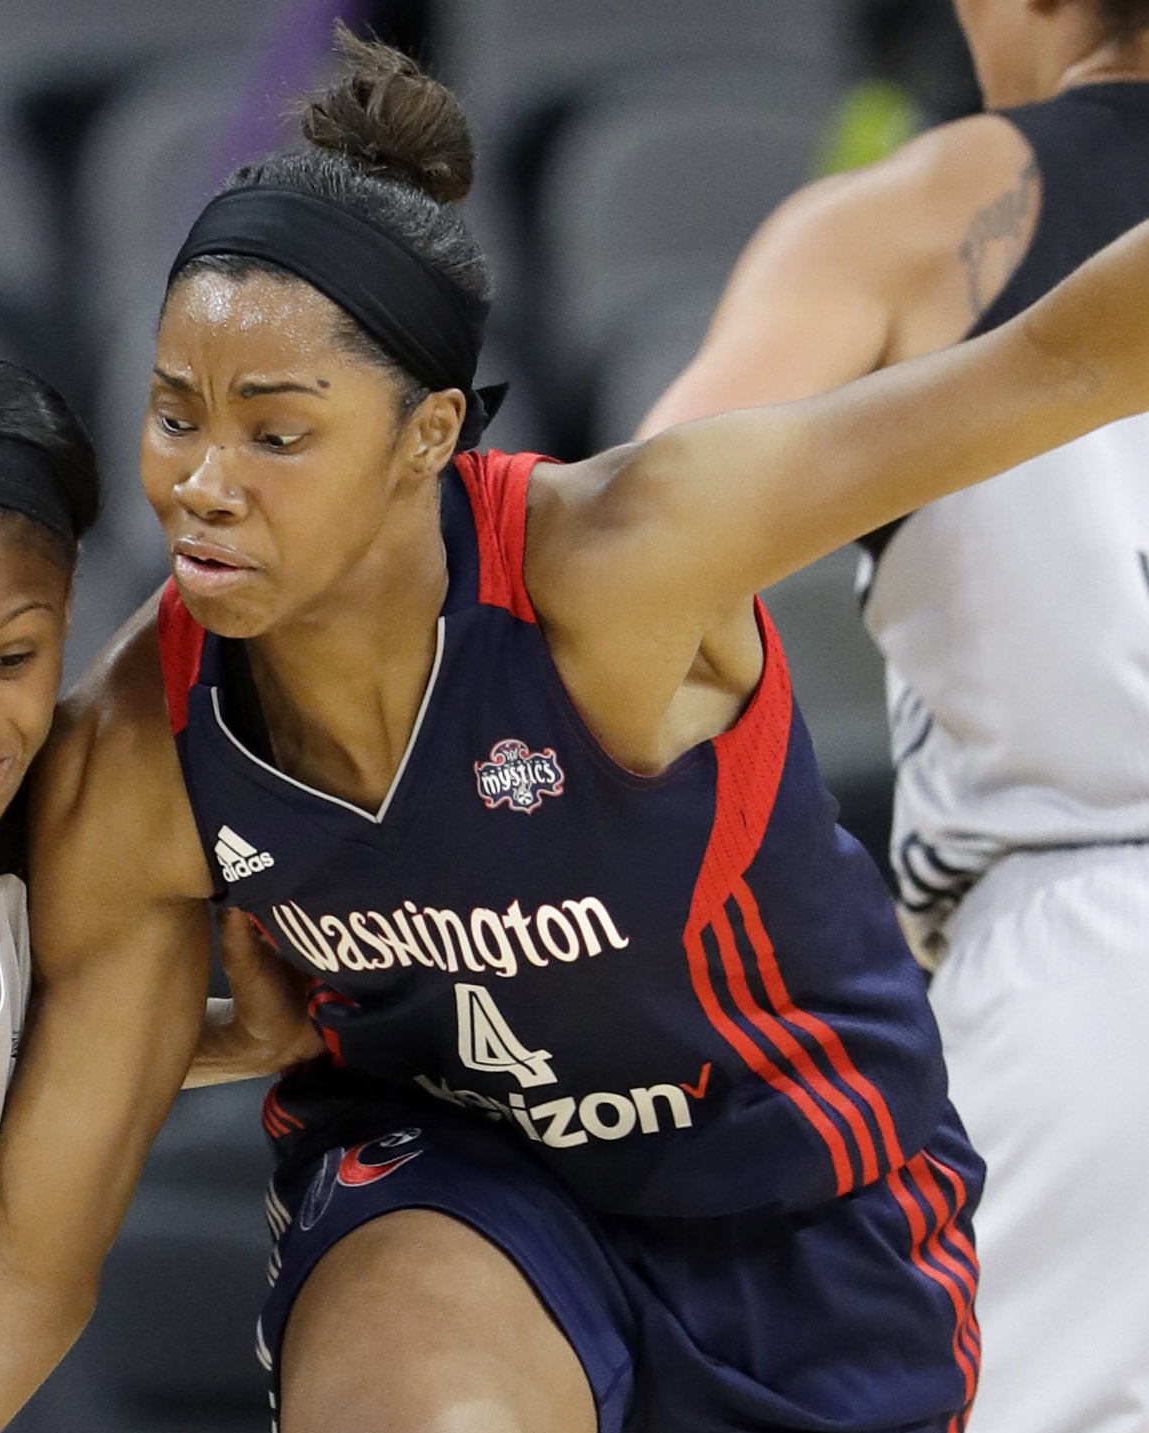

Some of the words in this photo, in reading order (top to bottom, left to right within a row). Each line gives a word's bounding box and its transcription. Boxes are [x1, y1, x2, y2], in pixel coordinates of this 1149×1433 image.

[481, 760, 557, 797] mystics
[216, 851, 275, 882] didas
[271, 895, 630, 979] Washington
[453, 982, 559, 1089] 4
